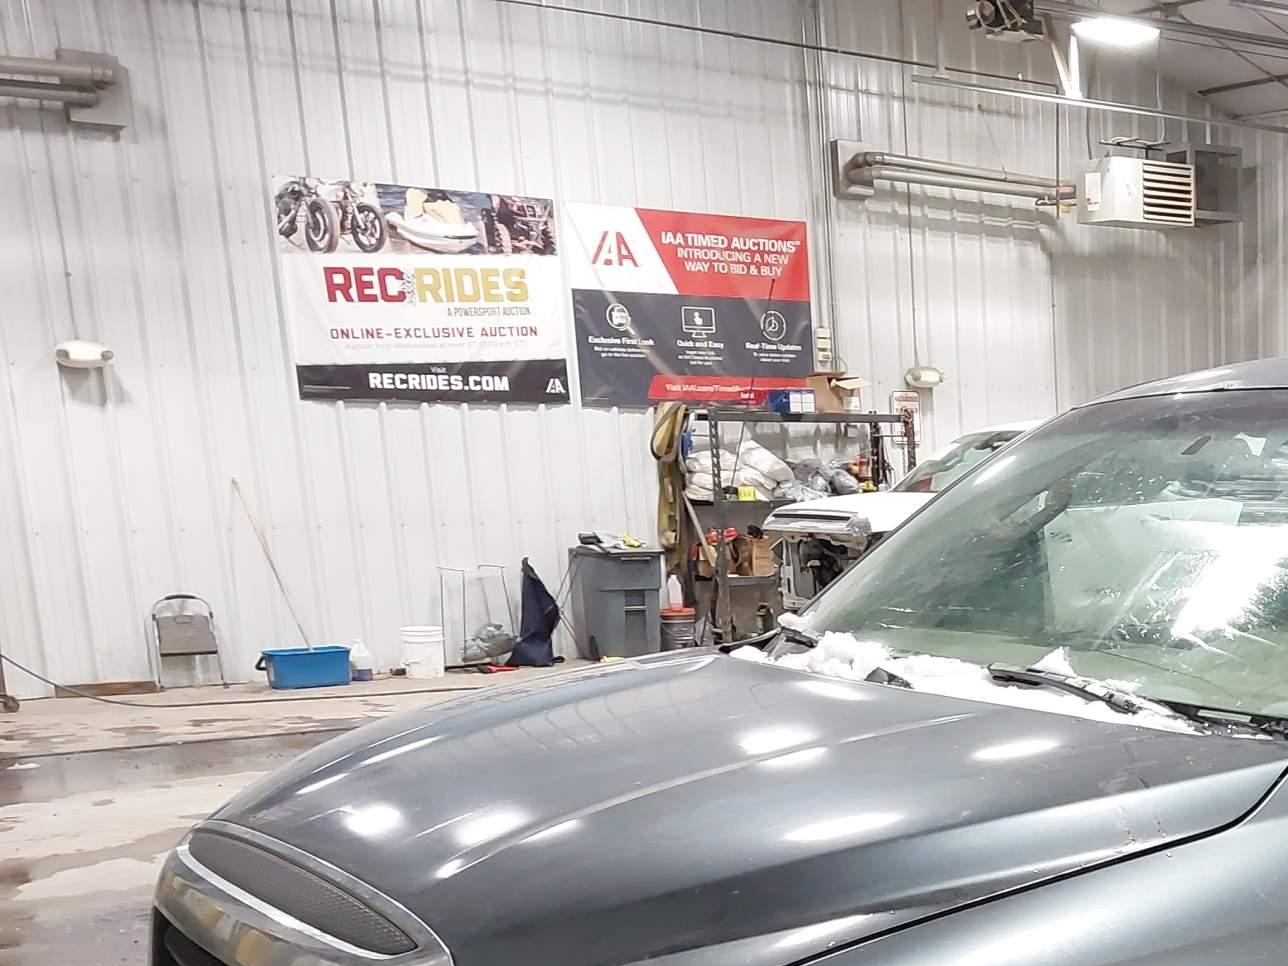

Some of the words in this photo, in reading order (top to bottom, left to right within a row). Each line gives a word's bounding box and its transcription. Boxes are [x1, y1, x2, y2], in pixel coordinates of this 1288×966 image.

[661, 231, 684, 246] IAA
[684, 233, 728, 249] TIMED
[731, 236, 797, 253] AUCTIONS
[677, 247, 751, 263] INTRODUCING
[754, 253, 763, 263] A
[763, 253, 789, 265] NEW
[684, 260, 711, 273] WAY
[712, 262, 728, 274] TO
[730, 263, 747, 275] BID
[749, 265, 758, 276] &
[760, 265, 783, 277] BUY
[323, 266, 407, 303] REC
[413, 267, 530, 304] RIDES
[447, 307, 454, 317] A
[453, 306, 501, 317] POWERSPORT
[502, 306, 531, 316] AUCTION
[330, 327, 475, 340] ONLINE-EXCLUSIVE
[480, 325, 538, 338] AUCTION
[588, 336, 621, 345] Exclusive
[621, 337, 637, 345] First
[638, 338, 655, 346] Look
[676, 339, 694, 347] Quick
[708, 340, 724, 349] Easy
[777, 343, 802, 351] Updates
[430, 366, 446, 374] Visit
[369, 372, 510, 392] RECRIDES.COM
